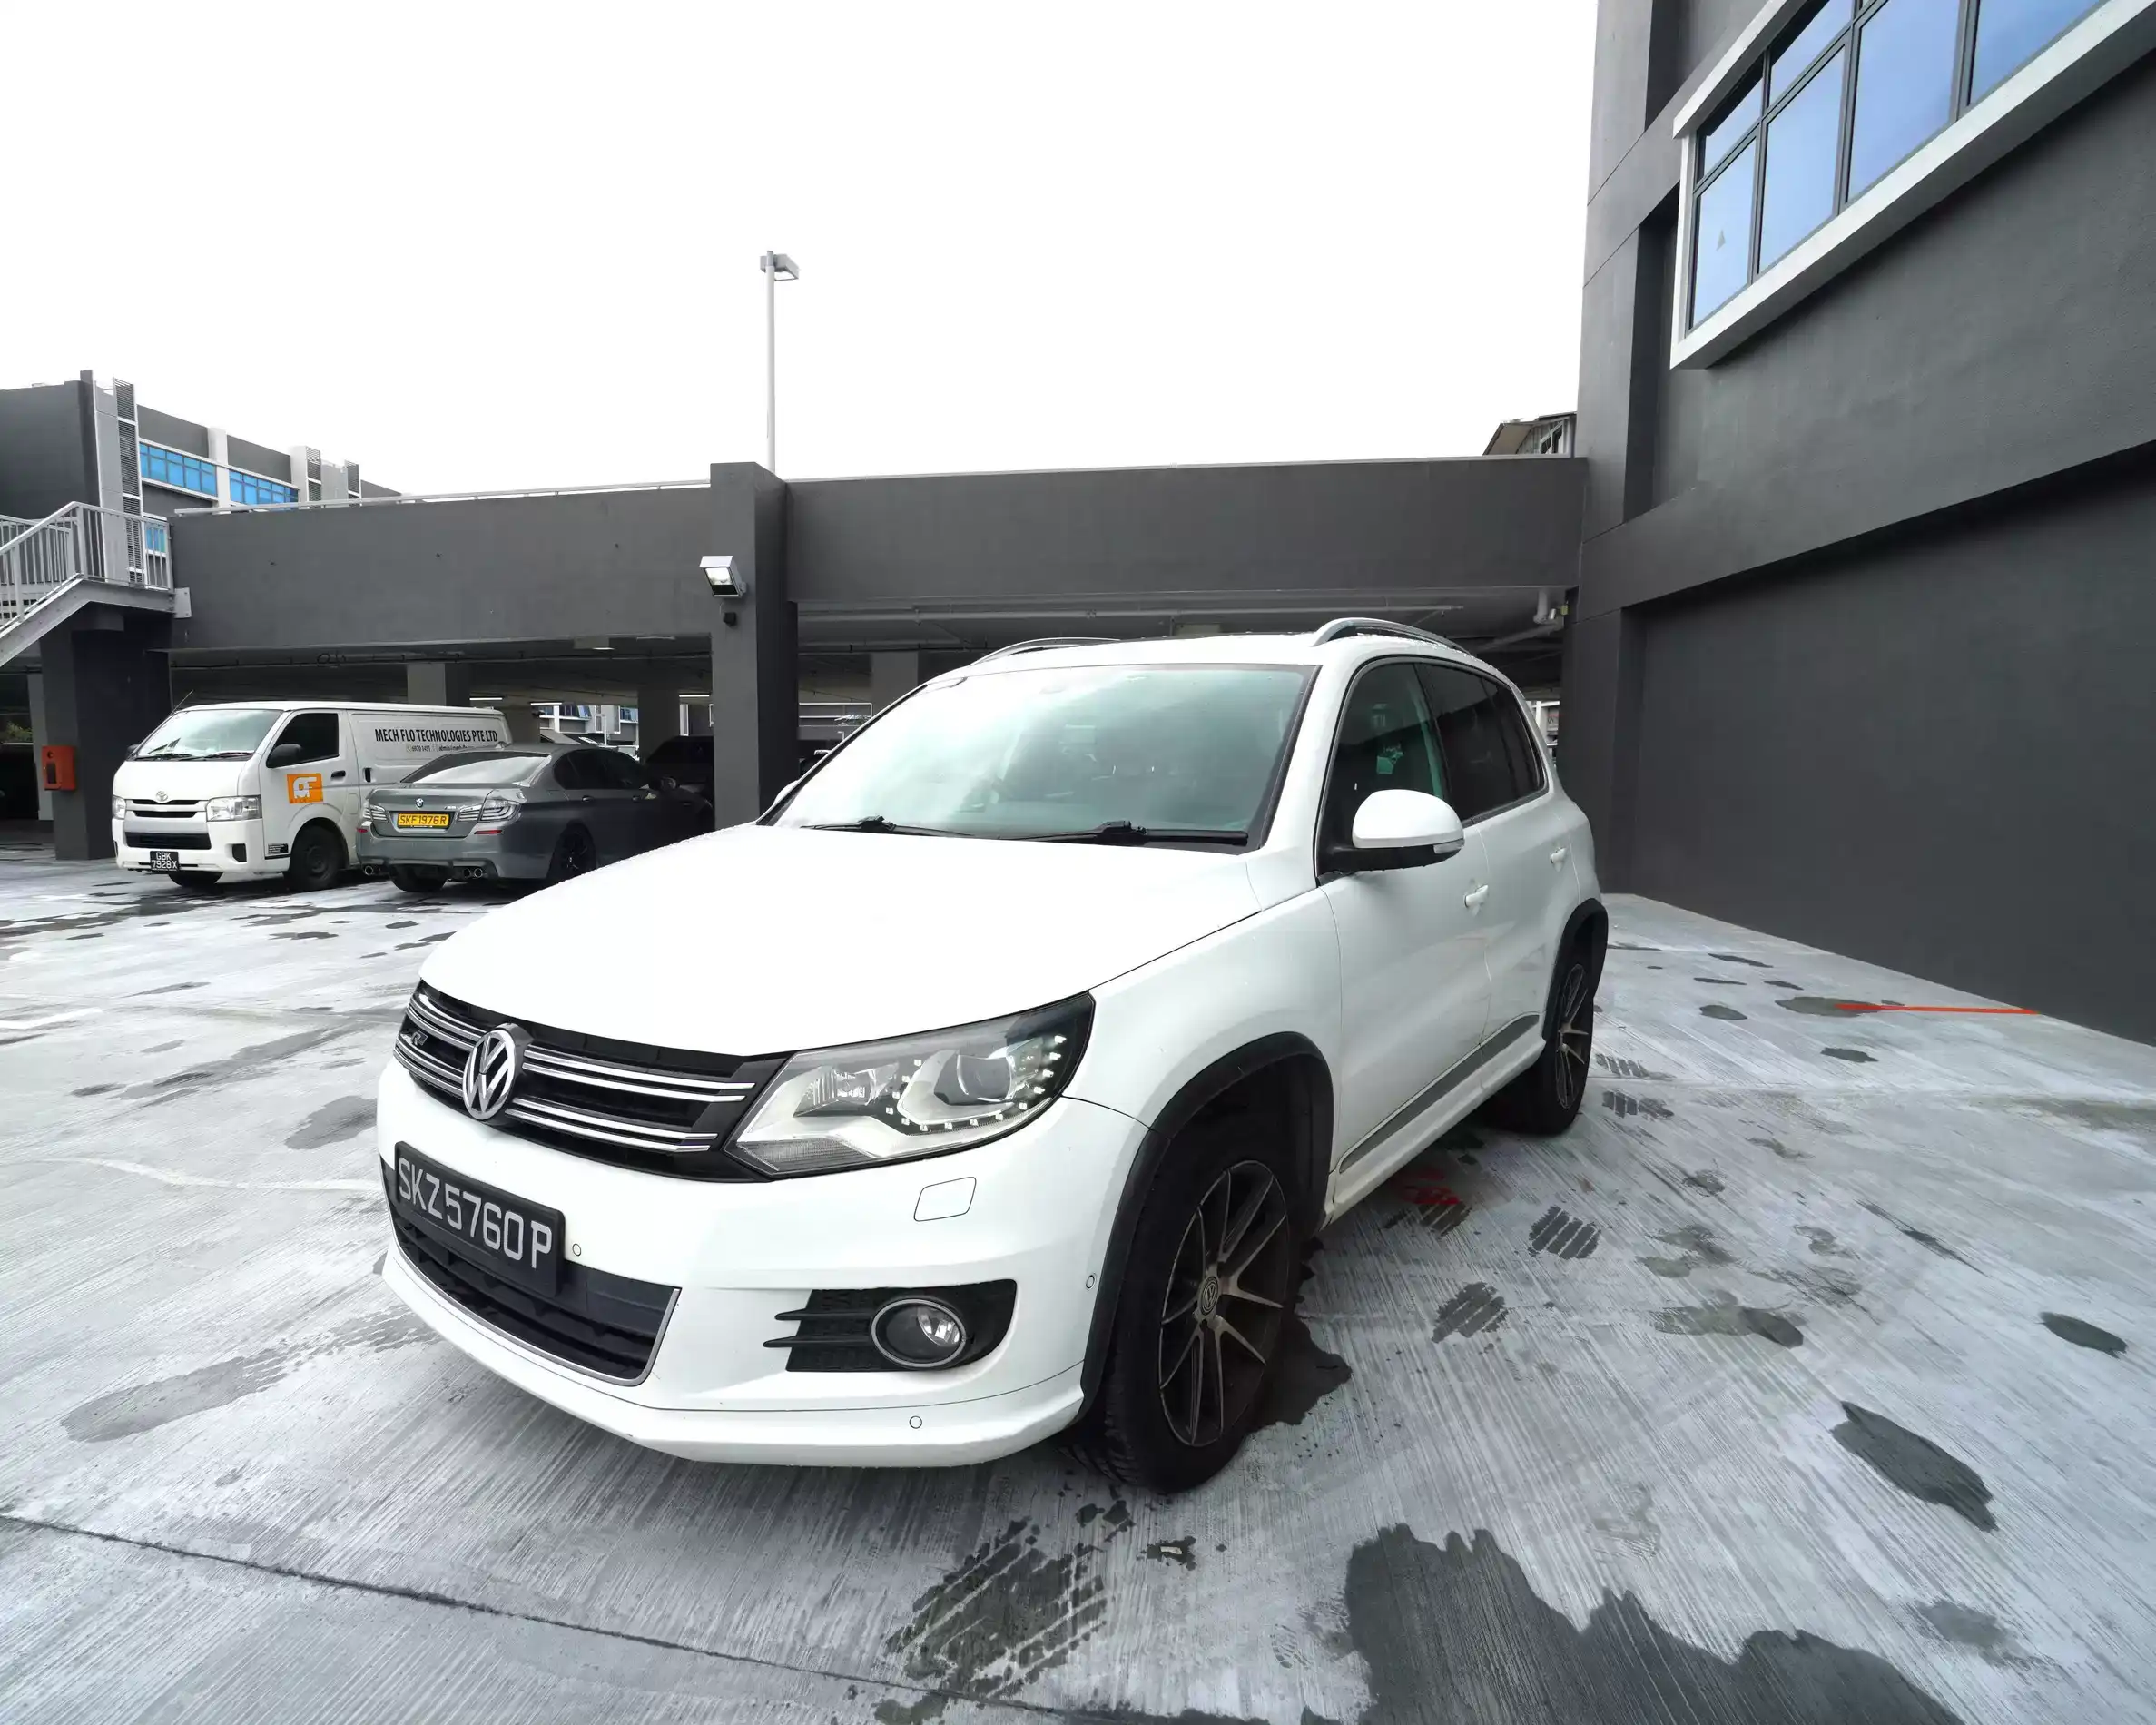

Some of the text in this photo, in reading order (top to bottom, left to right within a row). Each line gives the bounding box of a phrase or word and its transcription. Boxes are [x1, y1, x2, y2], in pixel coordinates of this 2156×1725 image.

[375, 729, 498, 742] MECH FLO TECHNOLOGIES PTE LTD
[400, 815, 447, 825] SKF1976R
[156, 852, 171, 861] GBK
[399, 1157, 552, 1268] SKZ5760P
